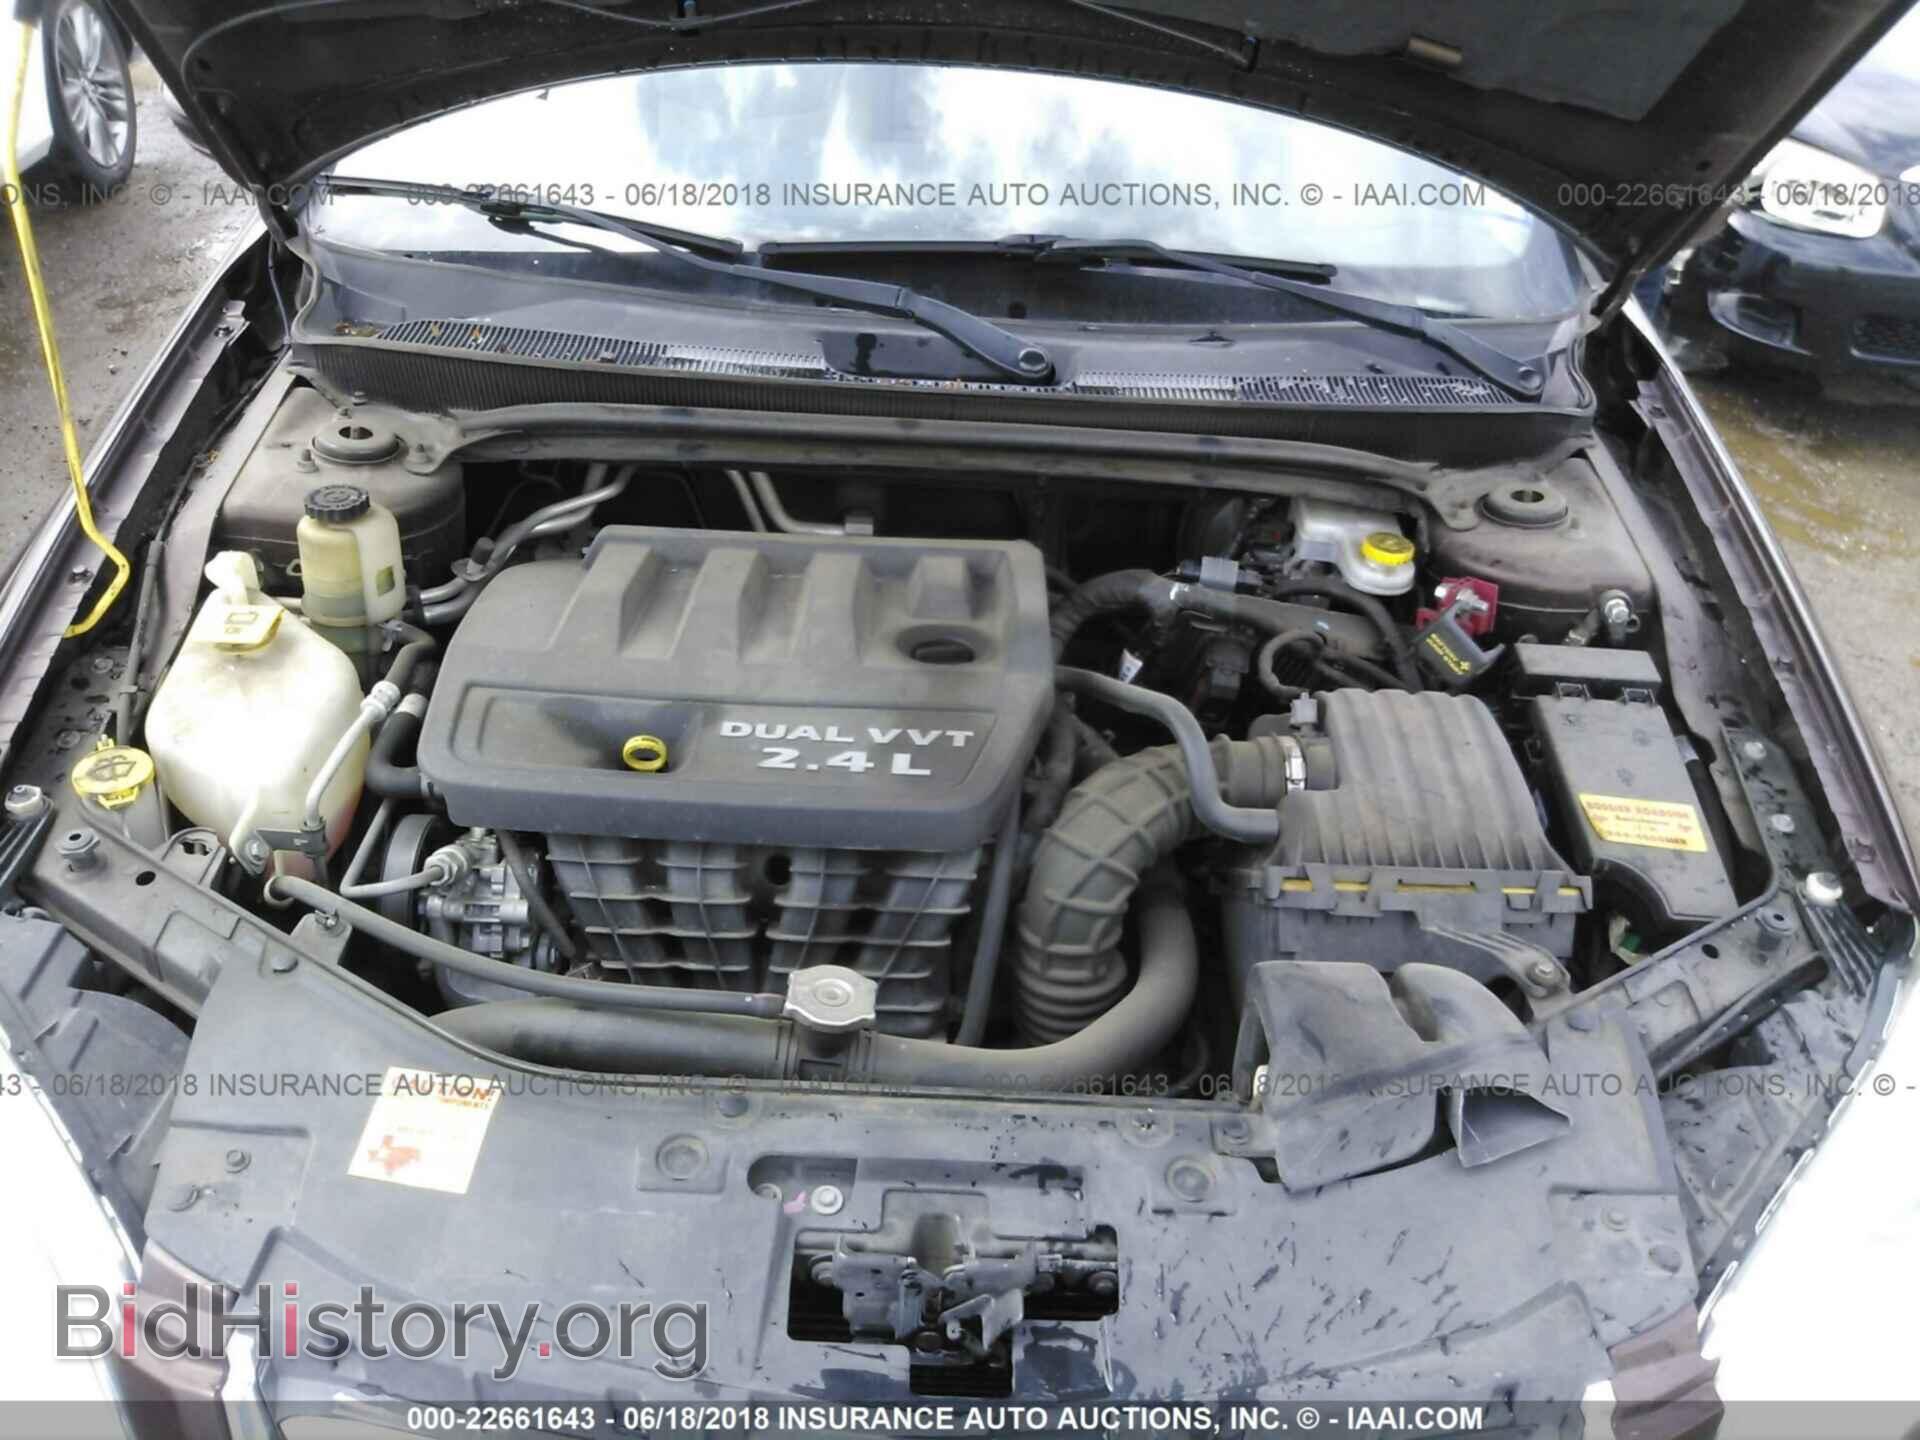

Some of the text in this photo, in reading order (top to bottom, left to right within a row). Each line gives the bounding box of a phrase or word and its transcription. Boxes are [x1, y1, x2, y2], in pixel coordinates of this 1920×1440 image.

[720, 720, 975, 747] DUAL VVT
[757, 747, 932, 776] 2.4 L
